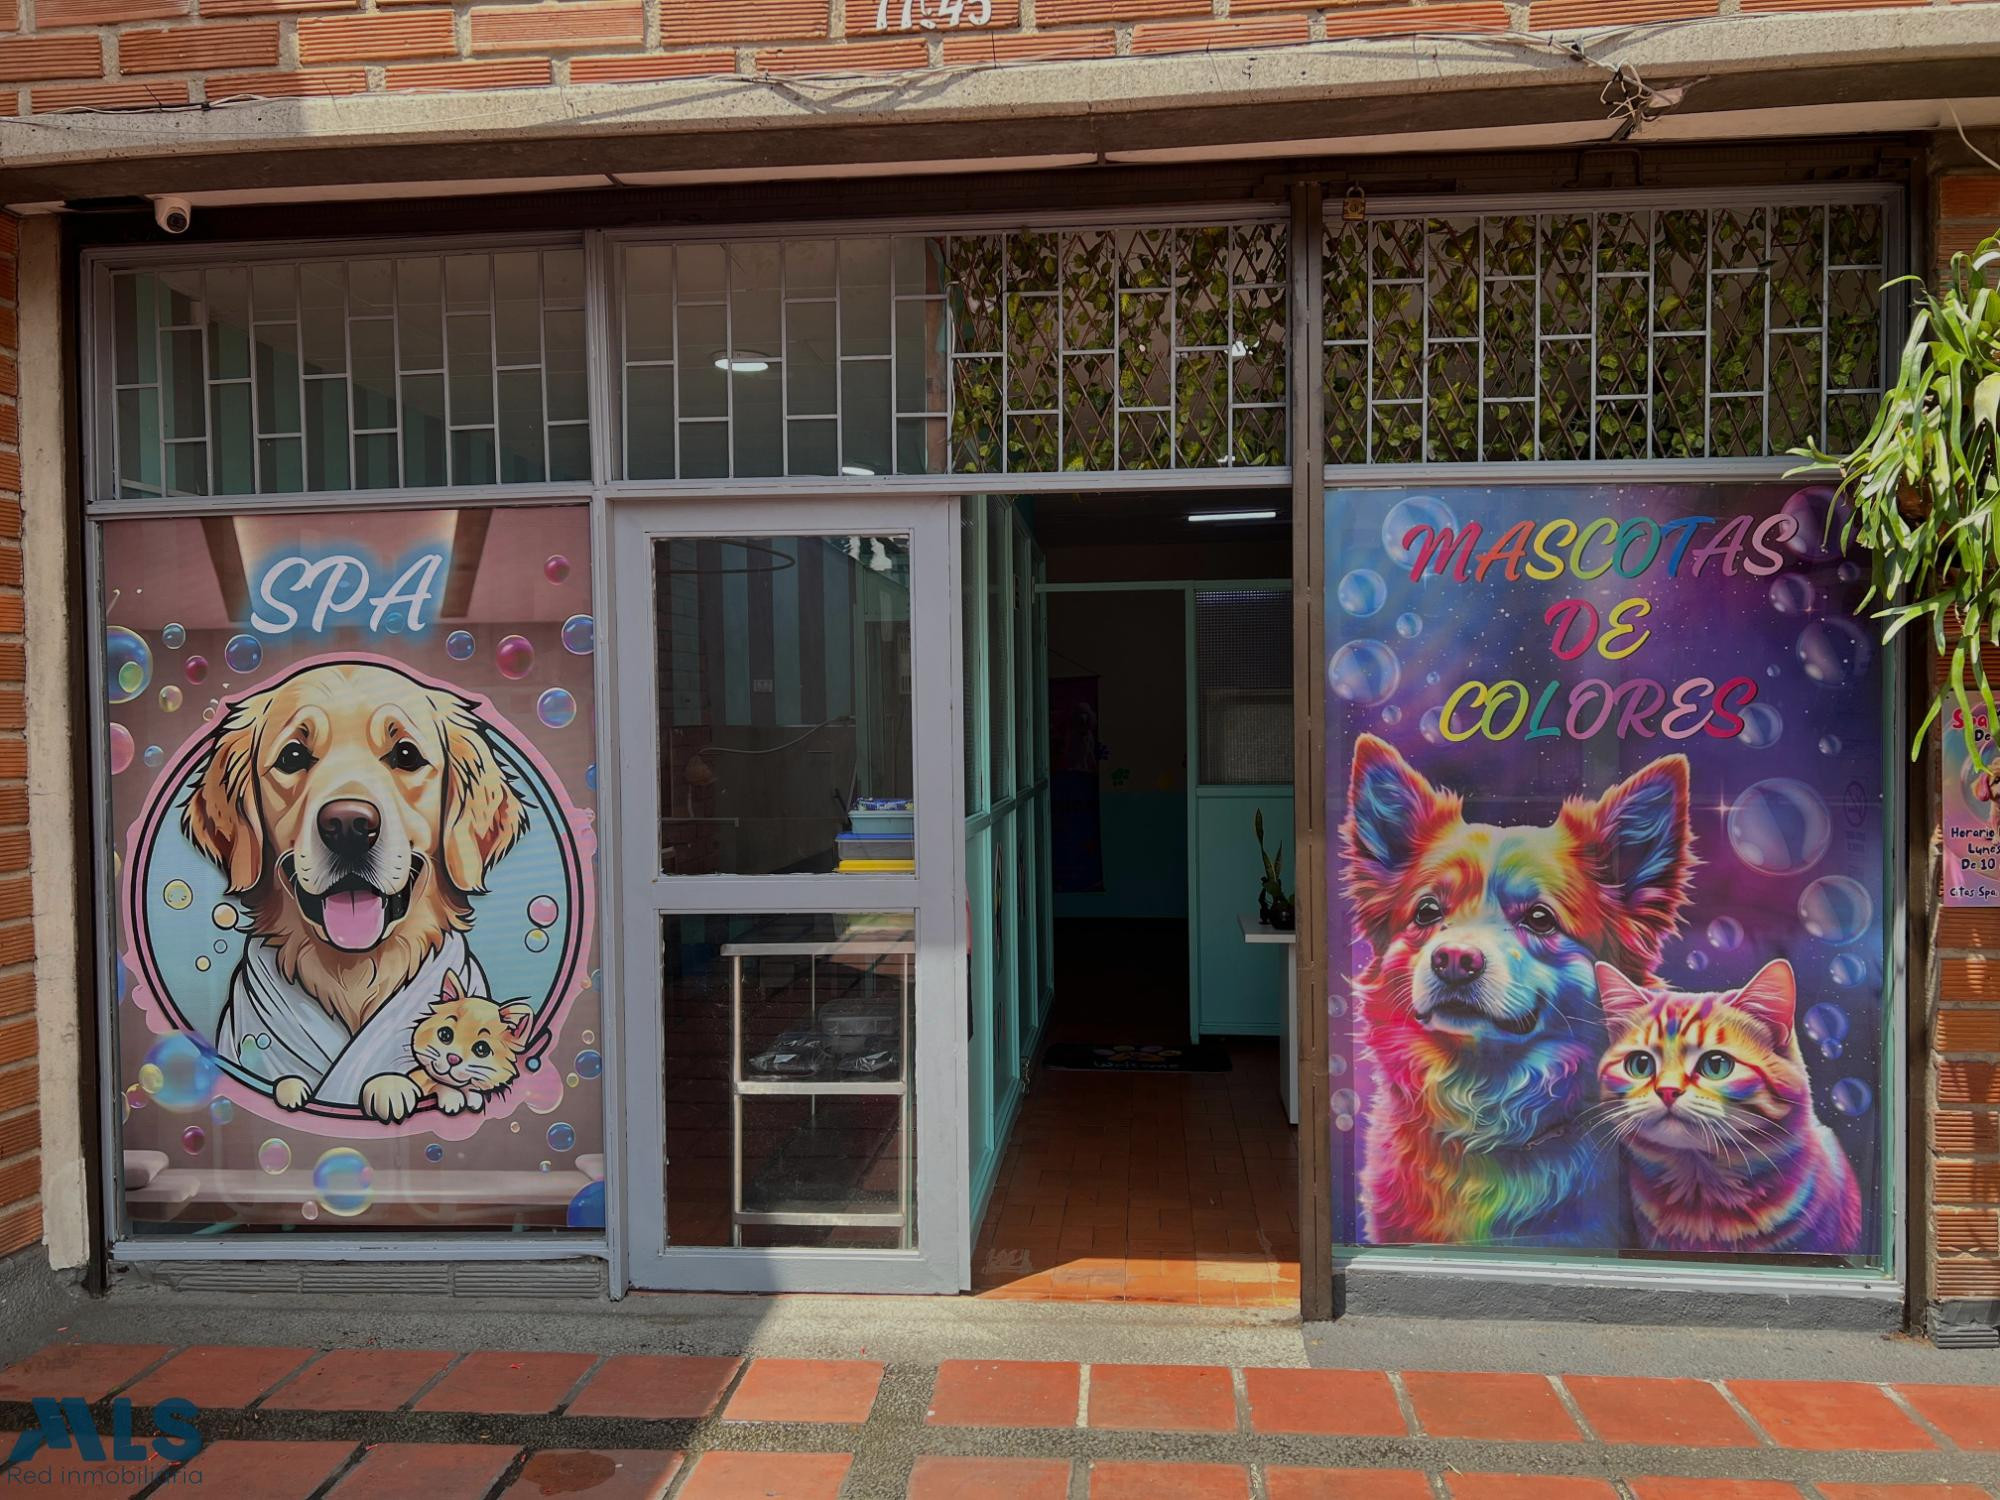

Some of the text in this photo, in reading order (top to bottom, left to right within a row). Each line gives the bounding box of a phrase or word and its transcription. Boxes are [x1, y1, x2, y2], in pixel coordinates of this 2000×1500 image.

[1401, 513, 1799, 584] MASCOTAS
[250, 554, 444, 634] SPA
[1544, 597, 1652, 661] DE
[1438, 676, 1759, 742] COLORES
[1952, 707, 1989, 729] Sa
[1974, 728, 1991, 742] De
[1961, 857, 1996, 871] De 10
